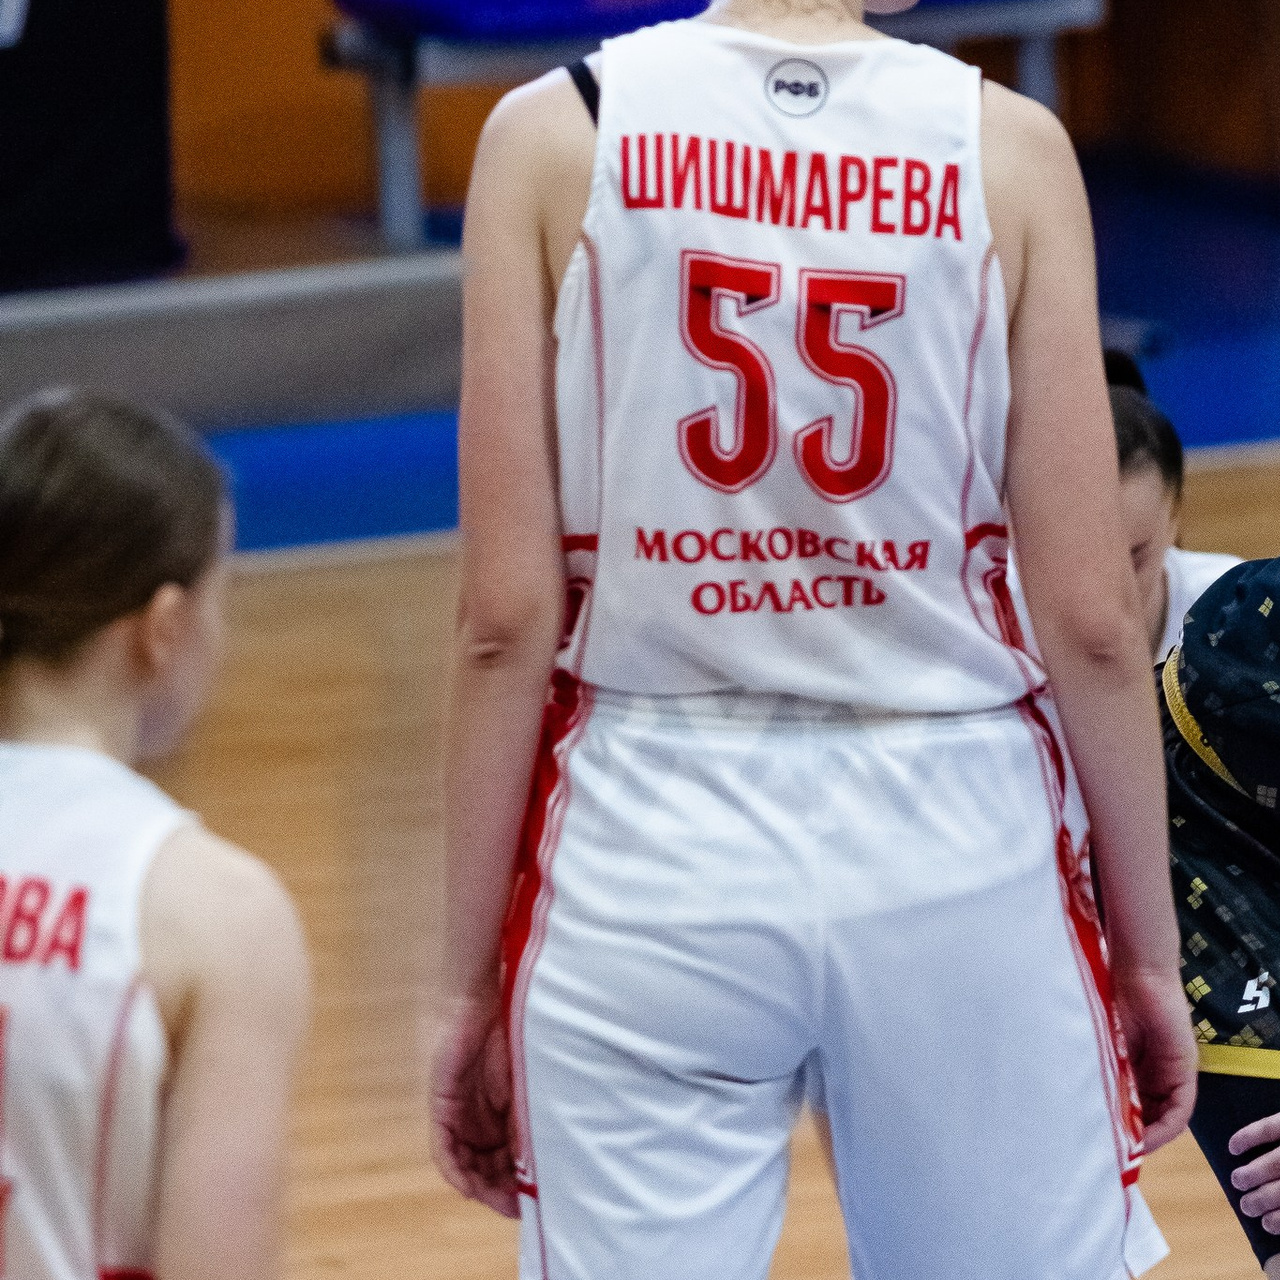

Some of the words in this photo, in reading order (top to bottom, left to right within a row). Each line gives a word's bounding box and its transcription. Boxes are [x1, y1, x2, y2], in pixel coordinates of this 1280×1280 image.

[773, 79, 820, 98] РФБ
[620, 132, 964, 242] ШИШМАРЕВА
[677, 249, 906, 504] 55
[634, 526, 931, 572] МОСКОВСКАЯ
[691, 574, 887, 615] ОБЛАСТЬ
